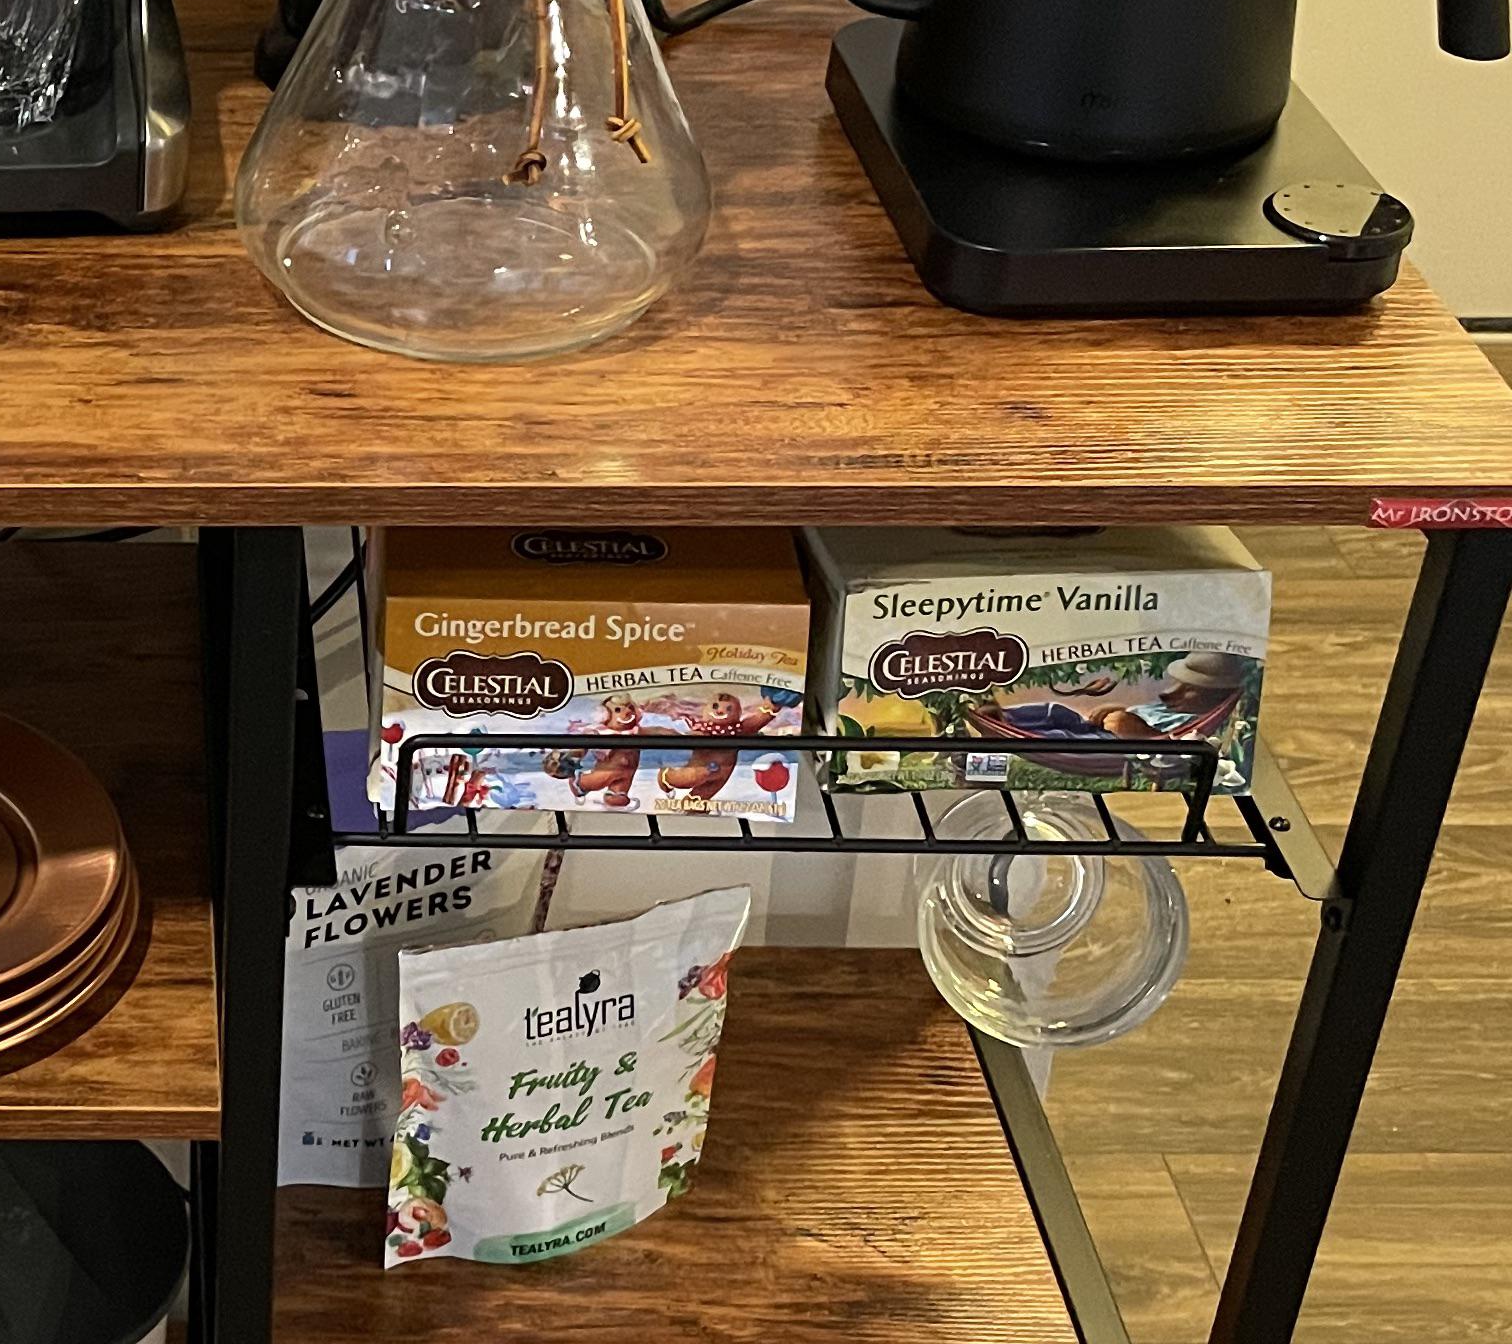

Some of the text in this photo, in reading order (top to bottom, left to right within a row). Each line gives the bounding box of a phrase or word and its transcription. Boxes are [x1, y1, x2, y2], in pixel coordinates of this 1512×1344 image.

[872, 584, 1159, 622] Sleepytime Vanilla
[414, 612, 596, 645] Gingerbread
[706, 646, 799, 667] Holiday Tea
[1041, 635, 1253, 664] HERBAL TEA Caffeine Free
[586, 666, 792, 692] HERBAL TEA Caffeine Free
[882, 649, 1012, 682] CELESTIAL
[906, 673, 985, 685] SEASONINGS
[426, 667, 559, 698] CELESTIAL
[451, 696, 532, 705] SEASONINGS
[305, 861, 380, 896] ANIC
[306, 850, 492, 921] LAVENDER
[304, 885, 473, 950] FLOWERS
[322, 992, 362, 1013] GLUTEN
[331, 1008, 358, 1026] FREE
[524, 990, 635, 1038] tealyra
[508, 1050, 638, 1100] Fruity &
[340, 1102, 388, 1117] FLOWERS
[352, 1089, 376, 1103] RAW
[480, 1087, 655, 1143] Herbal Tea
[498, 1151, 525, 1162] Pure
[539, 1136, 598, 1156] Refreshing
[510, 1220, 607, 1257] TEALYRA.COM
